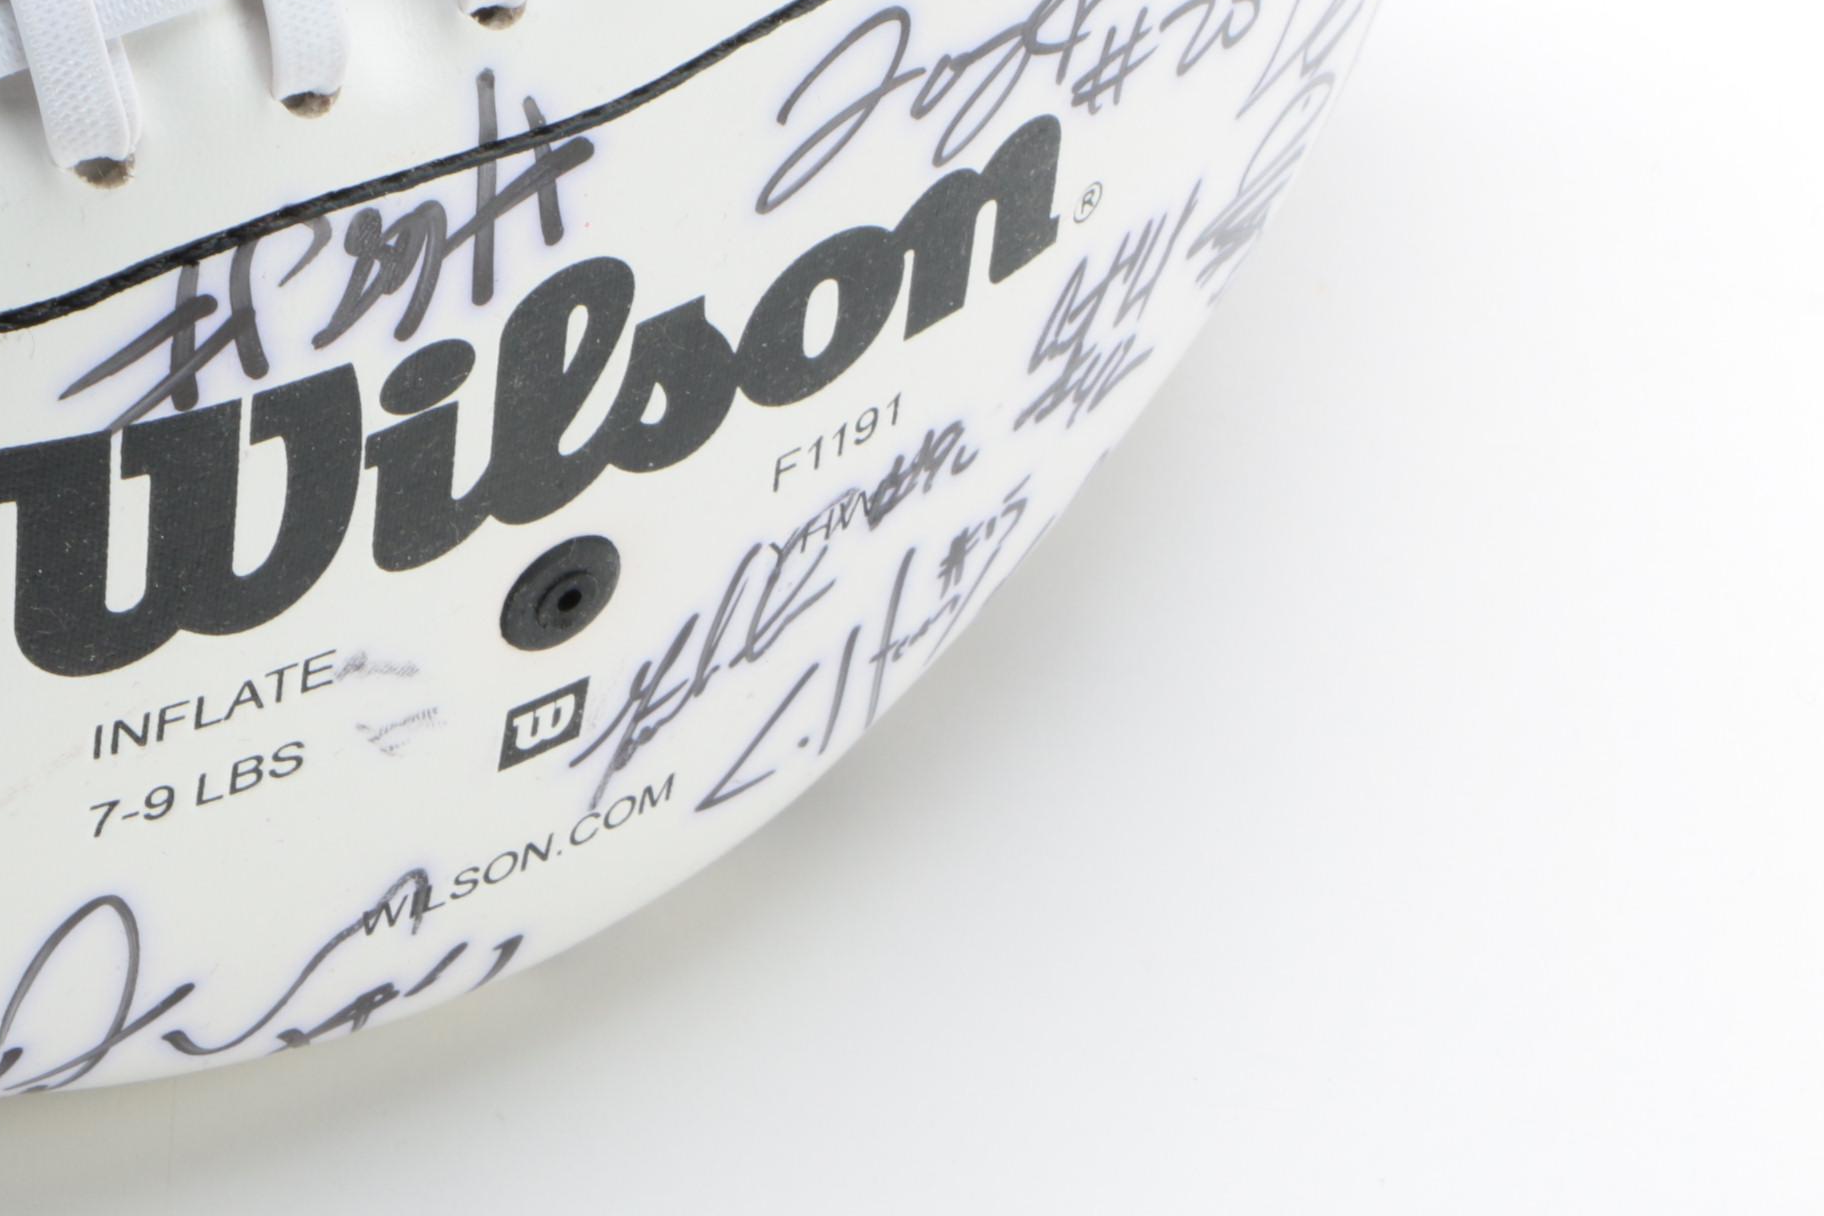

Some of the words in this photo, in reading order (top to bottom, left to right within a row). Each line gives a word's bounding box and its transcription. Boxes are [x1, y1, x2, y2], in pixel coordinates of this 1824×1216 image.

[772, 392, 902, 494] F1191
[90, 648, 338, 760] INFLATE
[88, 784, 176, 840] 7-9
[194, 740, 306, 808] LBS
[360, 772, 678, 940] WILSON.COM
